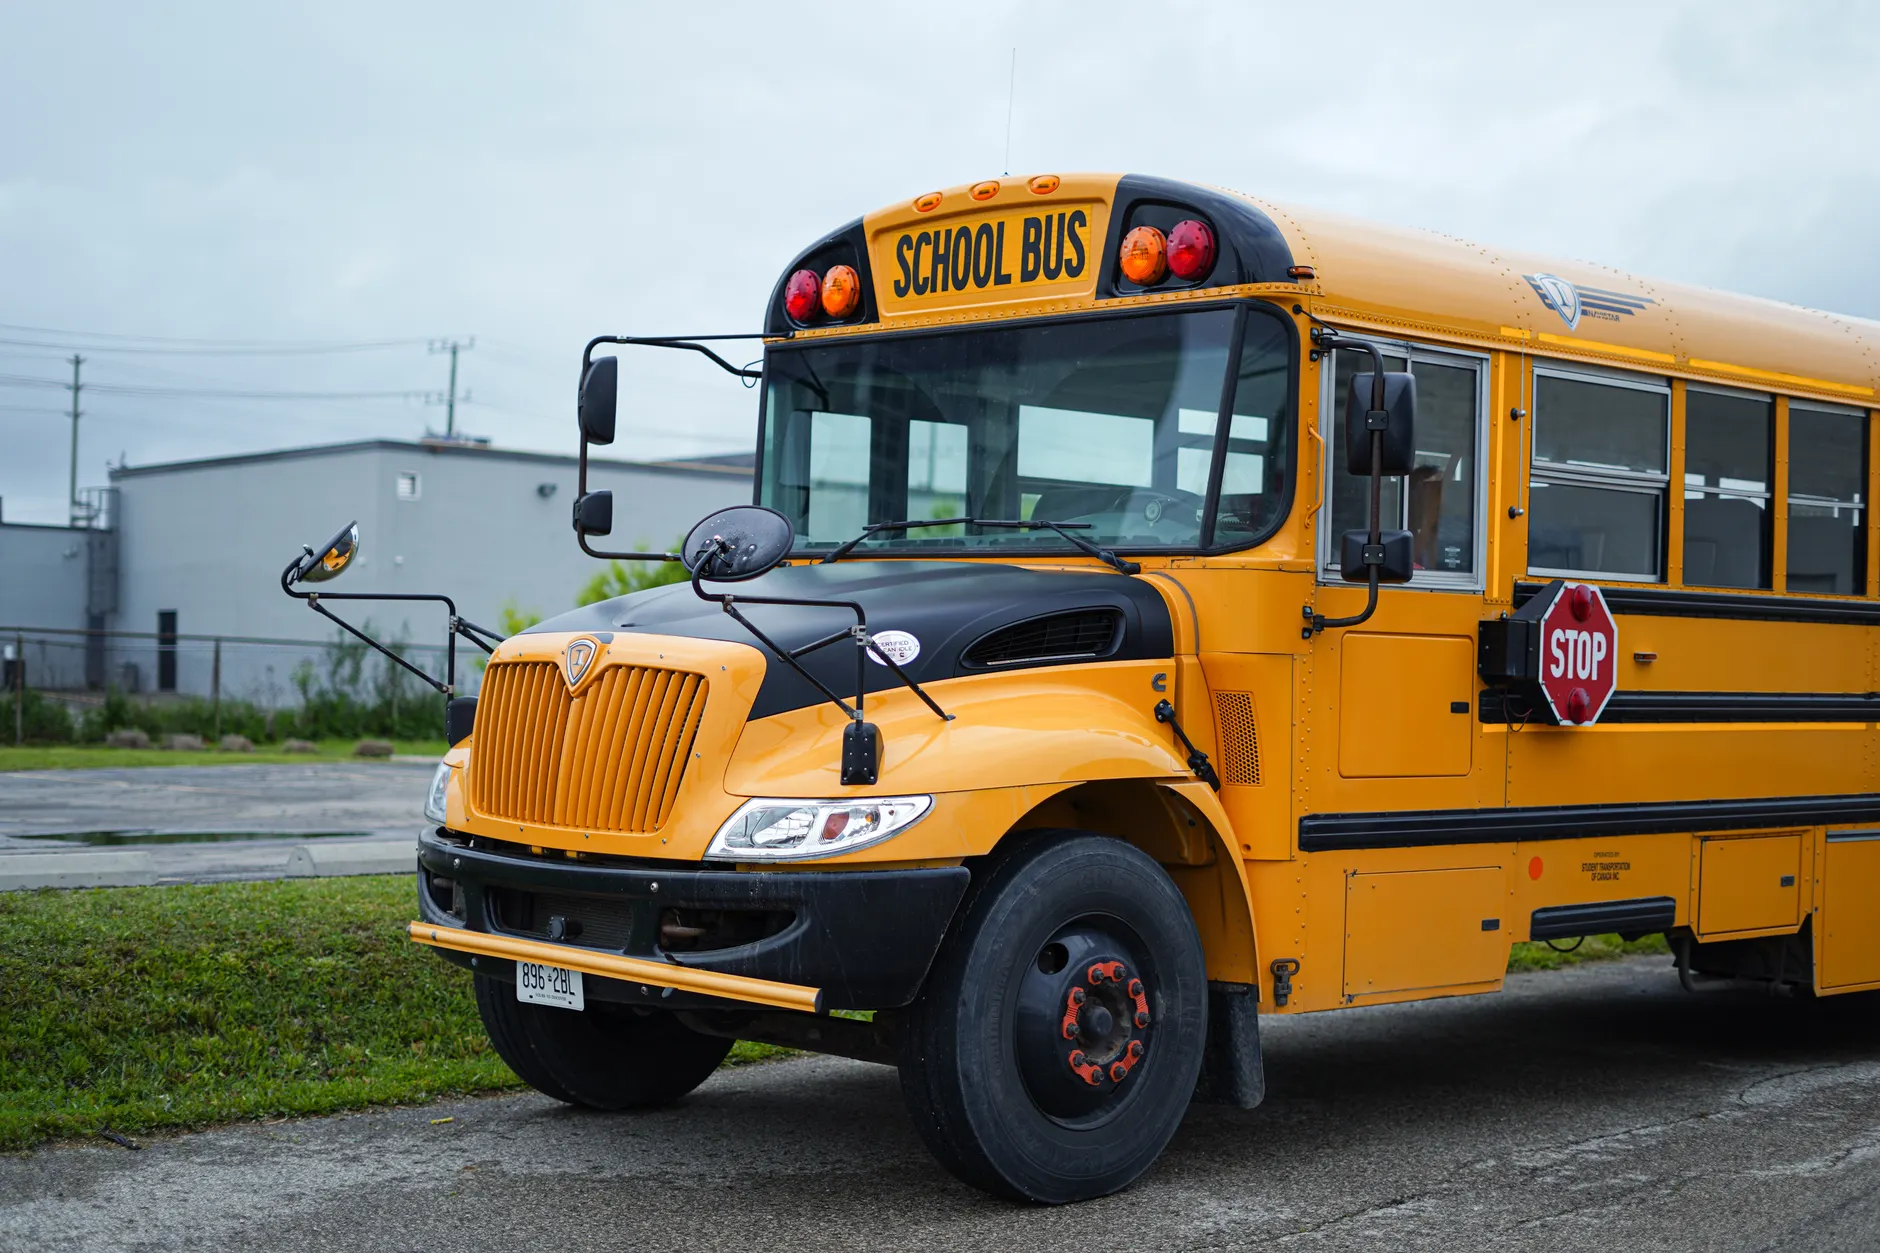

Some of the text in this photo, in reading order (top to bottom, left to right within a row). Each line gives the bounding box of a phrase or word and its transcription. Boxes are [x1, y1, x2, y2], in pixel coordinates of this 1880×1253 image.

[894, 210, 1087, 298] SCHOOL BUS
[1550, 628, 1607, 681] STOP
[1582, 862, 1631, 872] STUDENT TRANSPORTATION
[1591, 872, 1597, 881] OF
[1597, 872, 1612, 880] CANADA
